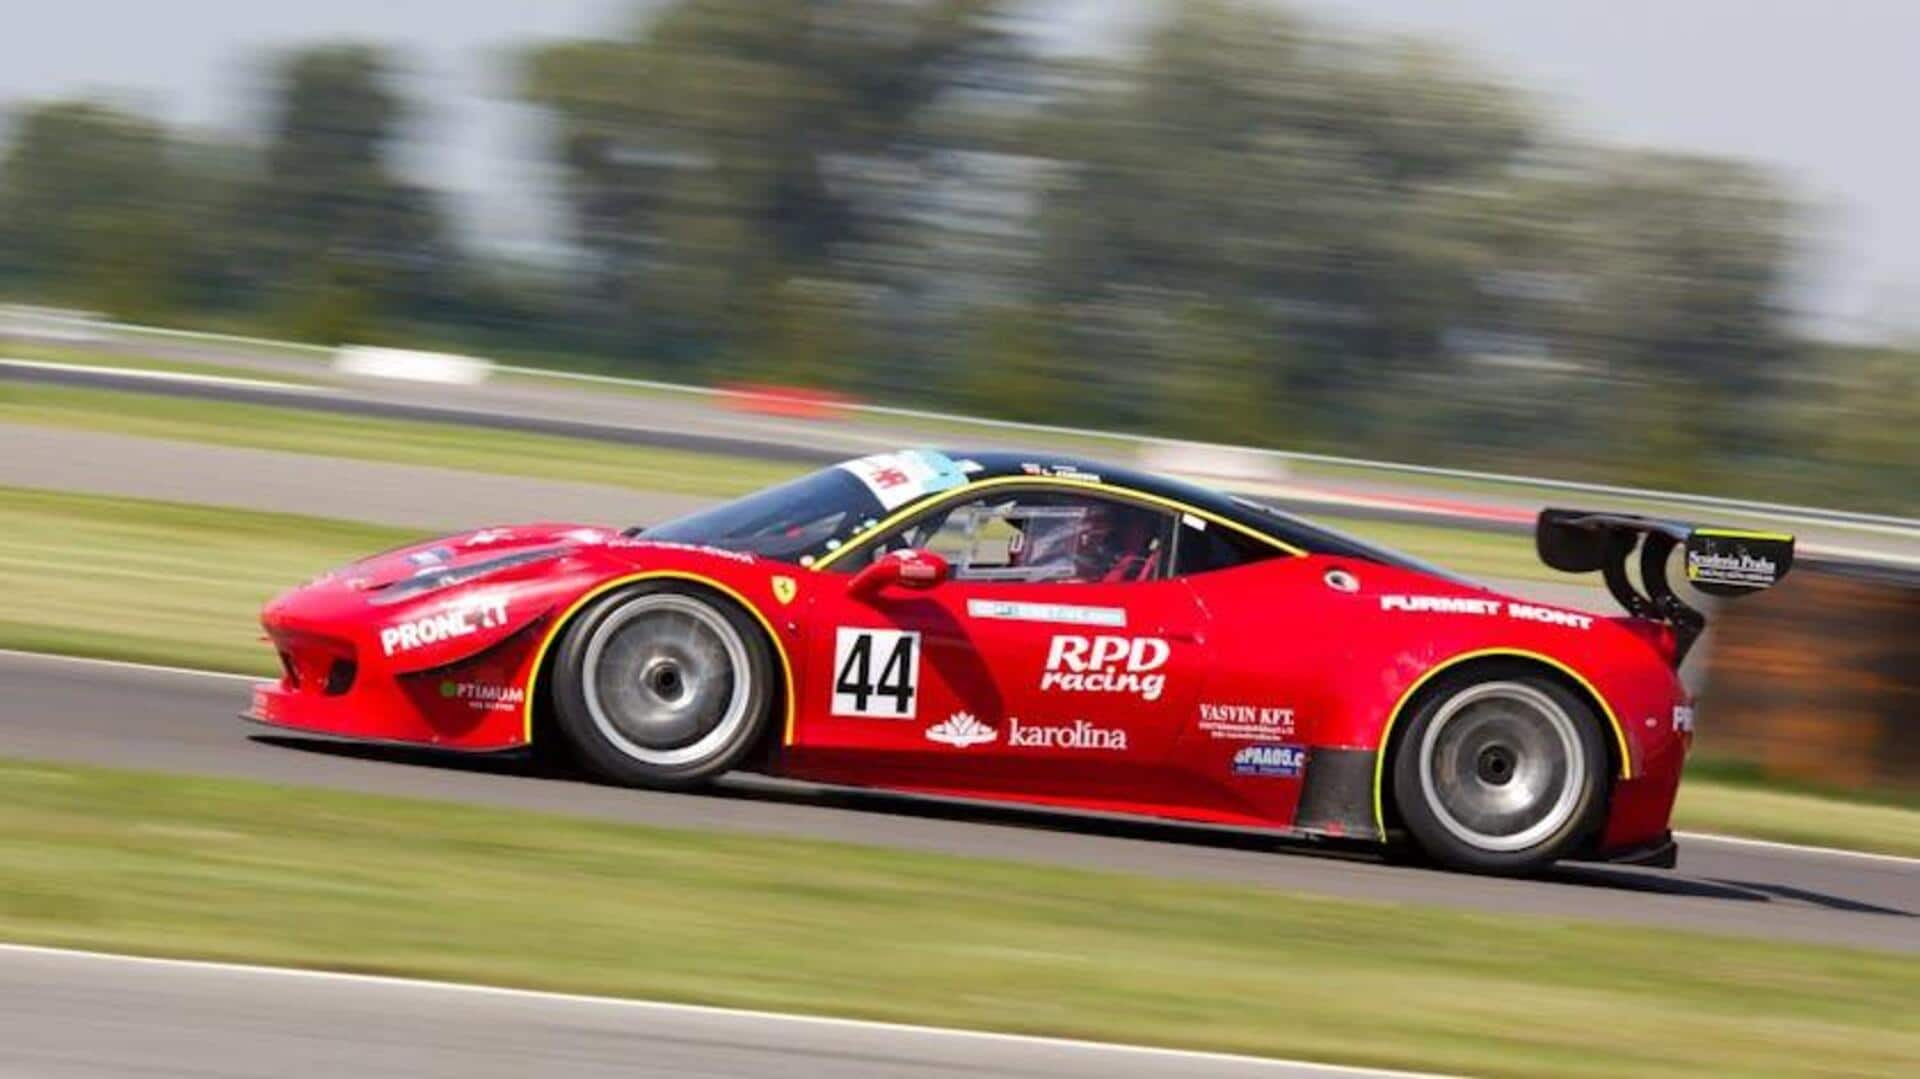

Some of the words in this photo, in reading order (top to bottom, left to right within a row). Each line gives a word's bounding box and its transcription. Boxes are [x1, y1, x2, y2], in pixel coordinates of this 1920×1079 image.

[1380, 595, 1500, 616] FURMET
[1507, 602, 1594, 630] MONT
[1046, 635, 1170, 672] RPD
[836, 633, 915, 714] 44
[1040, 666, 1166, 701] racing
